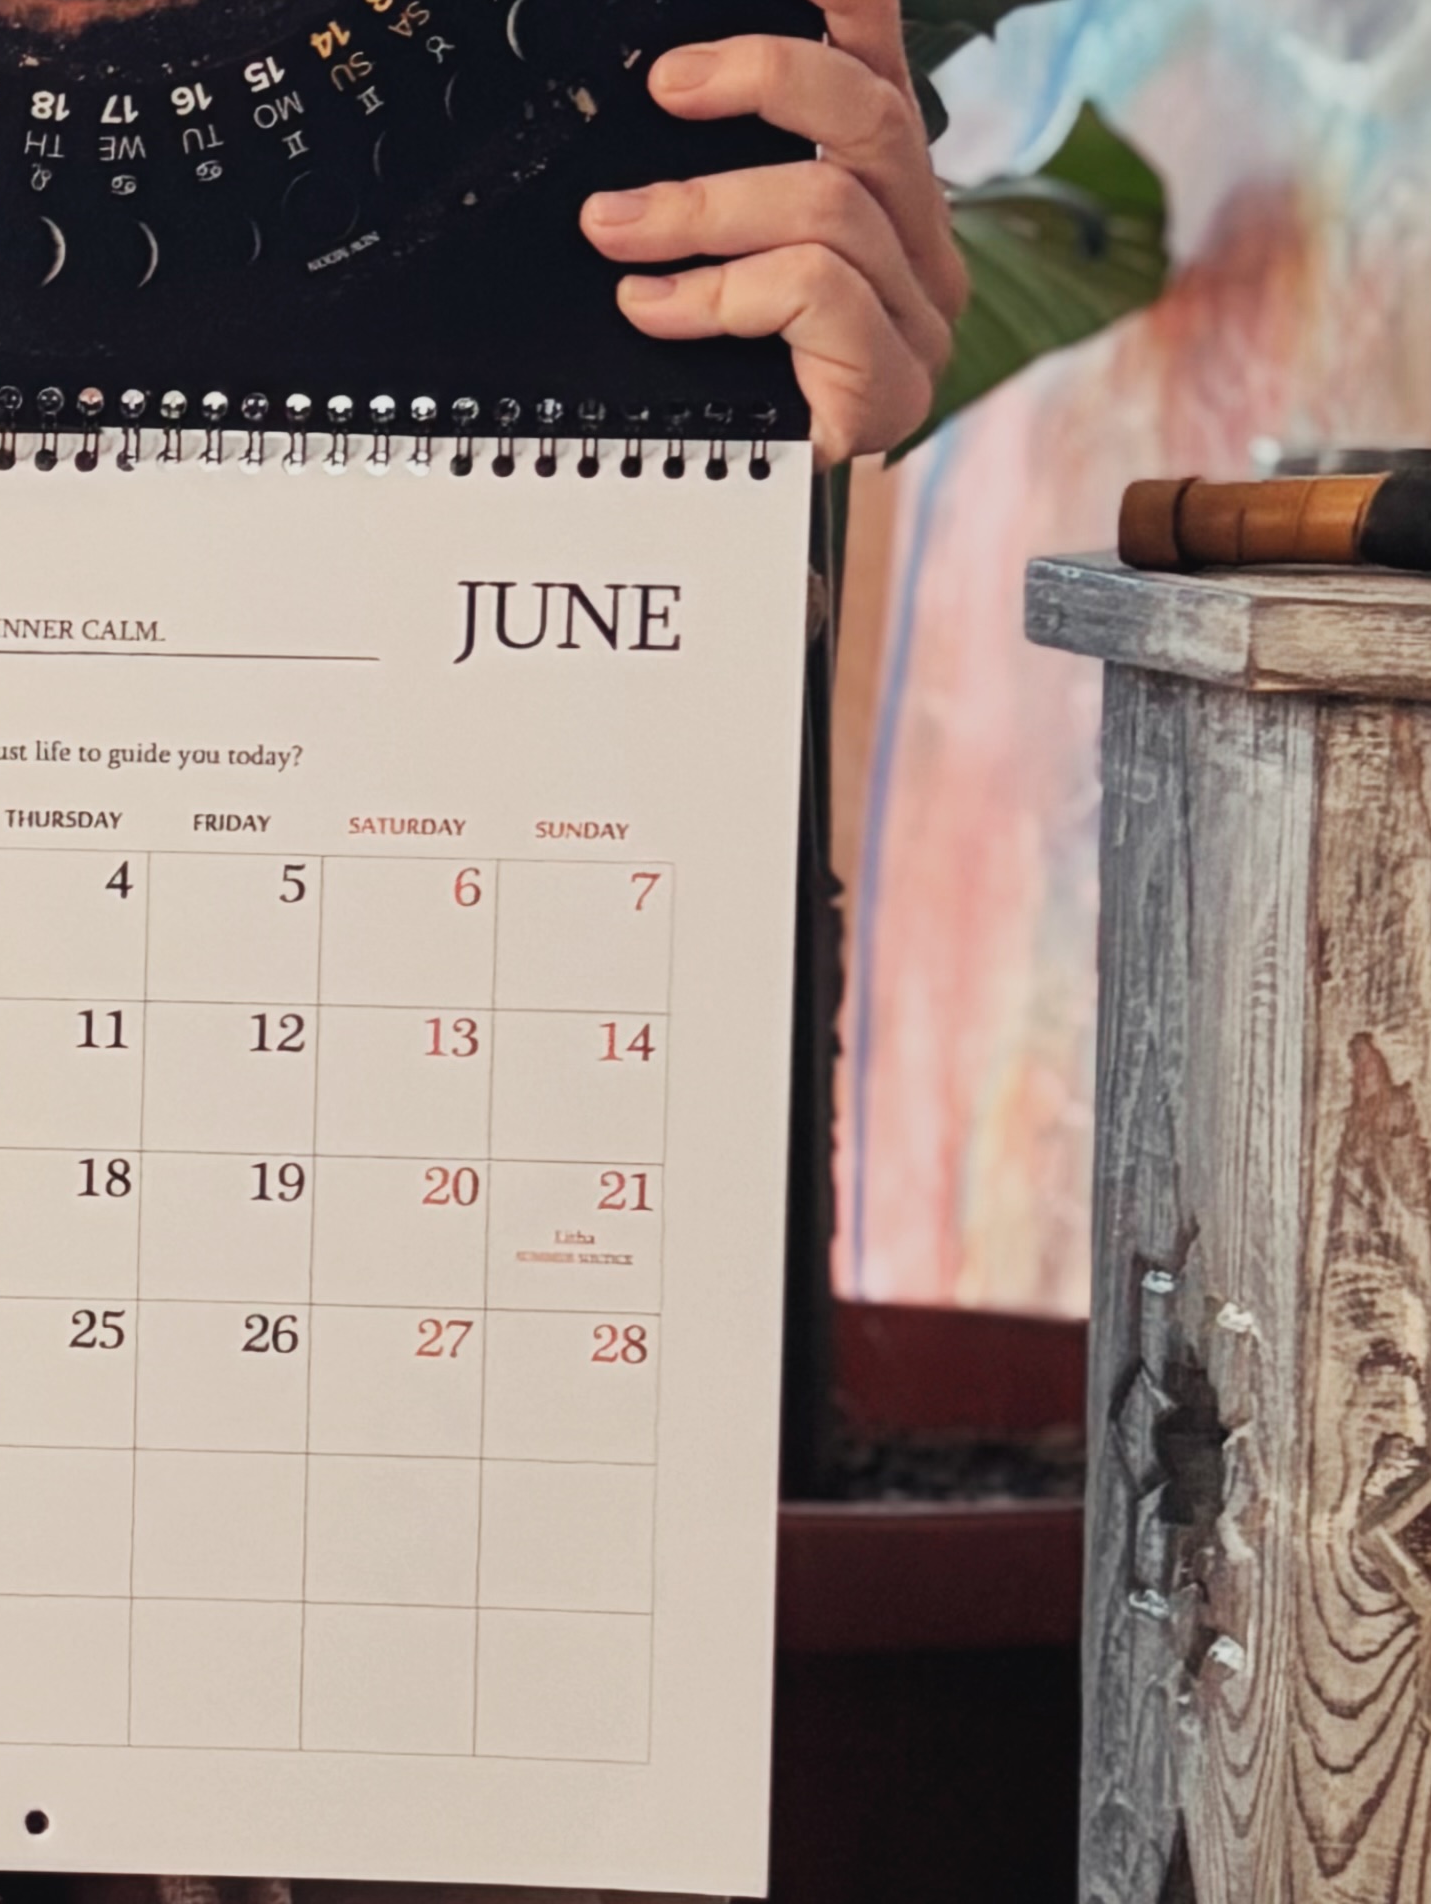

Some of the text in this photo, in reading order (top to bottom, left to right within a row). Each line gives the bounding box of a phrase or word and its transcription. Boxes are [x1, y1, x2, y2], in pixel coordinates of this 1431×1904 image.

[388, 1, 430, 37] SA
[310, 21, 351, 59] 14
[243, 56, 286, 94] 15
[330, 51, 373, 92] SU
[30, 90, 71, 123] 18
[100, 94, 140, 125] 17
[170, 82, 213, 116] 16
[253, 91, 305, 129] MO
[24, 130, 65, 159] TH
[98, 135, 147, 162] WE
[183, 124, 225, 155] TU
[81, 619, 166, 642] CALM.
[453, 580, 681, 665] JUNE
[35, 739, 72, 762] life
[78, 746, 102, 763] to
[107, 742, 172, 770] guide
[177, 749, 221, 771] you
[227, 743, 304, 773] today?
[4, 809, 123, 830] THURSDAY
[193, 813, 271, 833] FRIDAY
[348, 816, 467, 837] SATURDAY
[535, 820, 630, 841] SUNDAY
[105, 860, 134, 900] 4
[279, 863, 306, 904] 5
[454, 867, 482, 907] 6
[630, 871, 662, 912] 7
[76, 1009, 129, 1049] 11
[250, 1012, 306, 1053] 12
[425, 1017, 479, 1058] 13
[600, 1022, 656, 1062] 14
[77, 1158, 132, 1198] 18
[251, 1162, 306, 1203] 19
[422, 1166, 480, 1207] 20
[597, 1170, 653, 1212] 21
[68, 1309, 126, 1350] 25
[241, 1313, 299, 1354] 26
[415, 1318, 474, 1359] 27
[591, 1324, 648, 1365] 28
